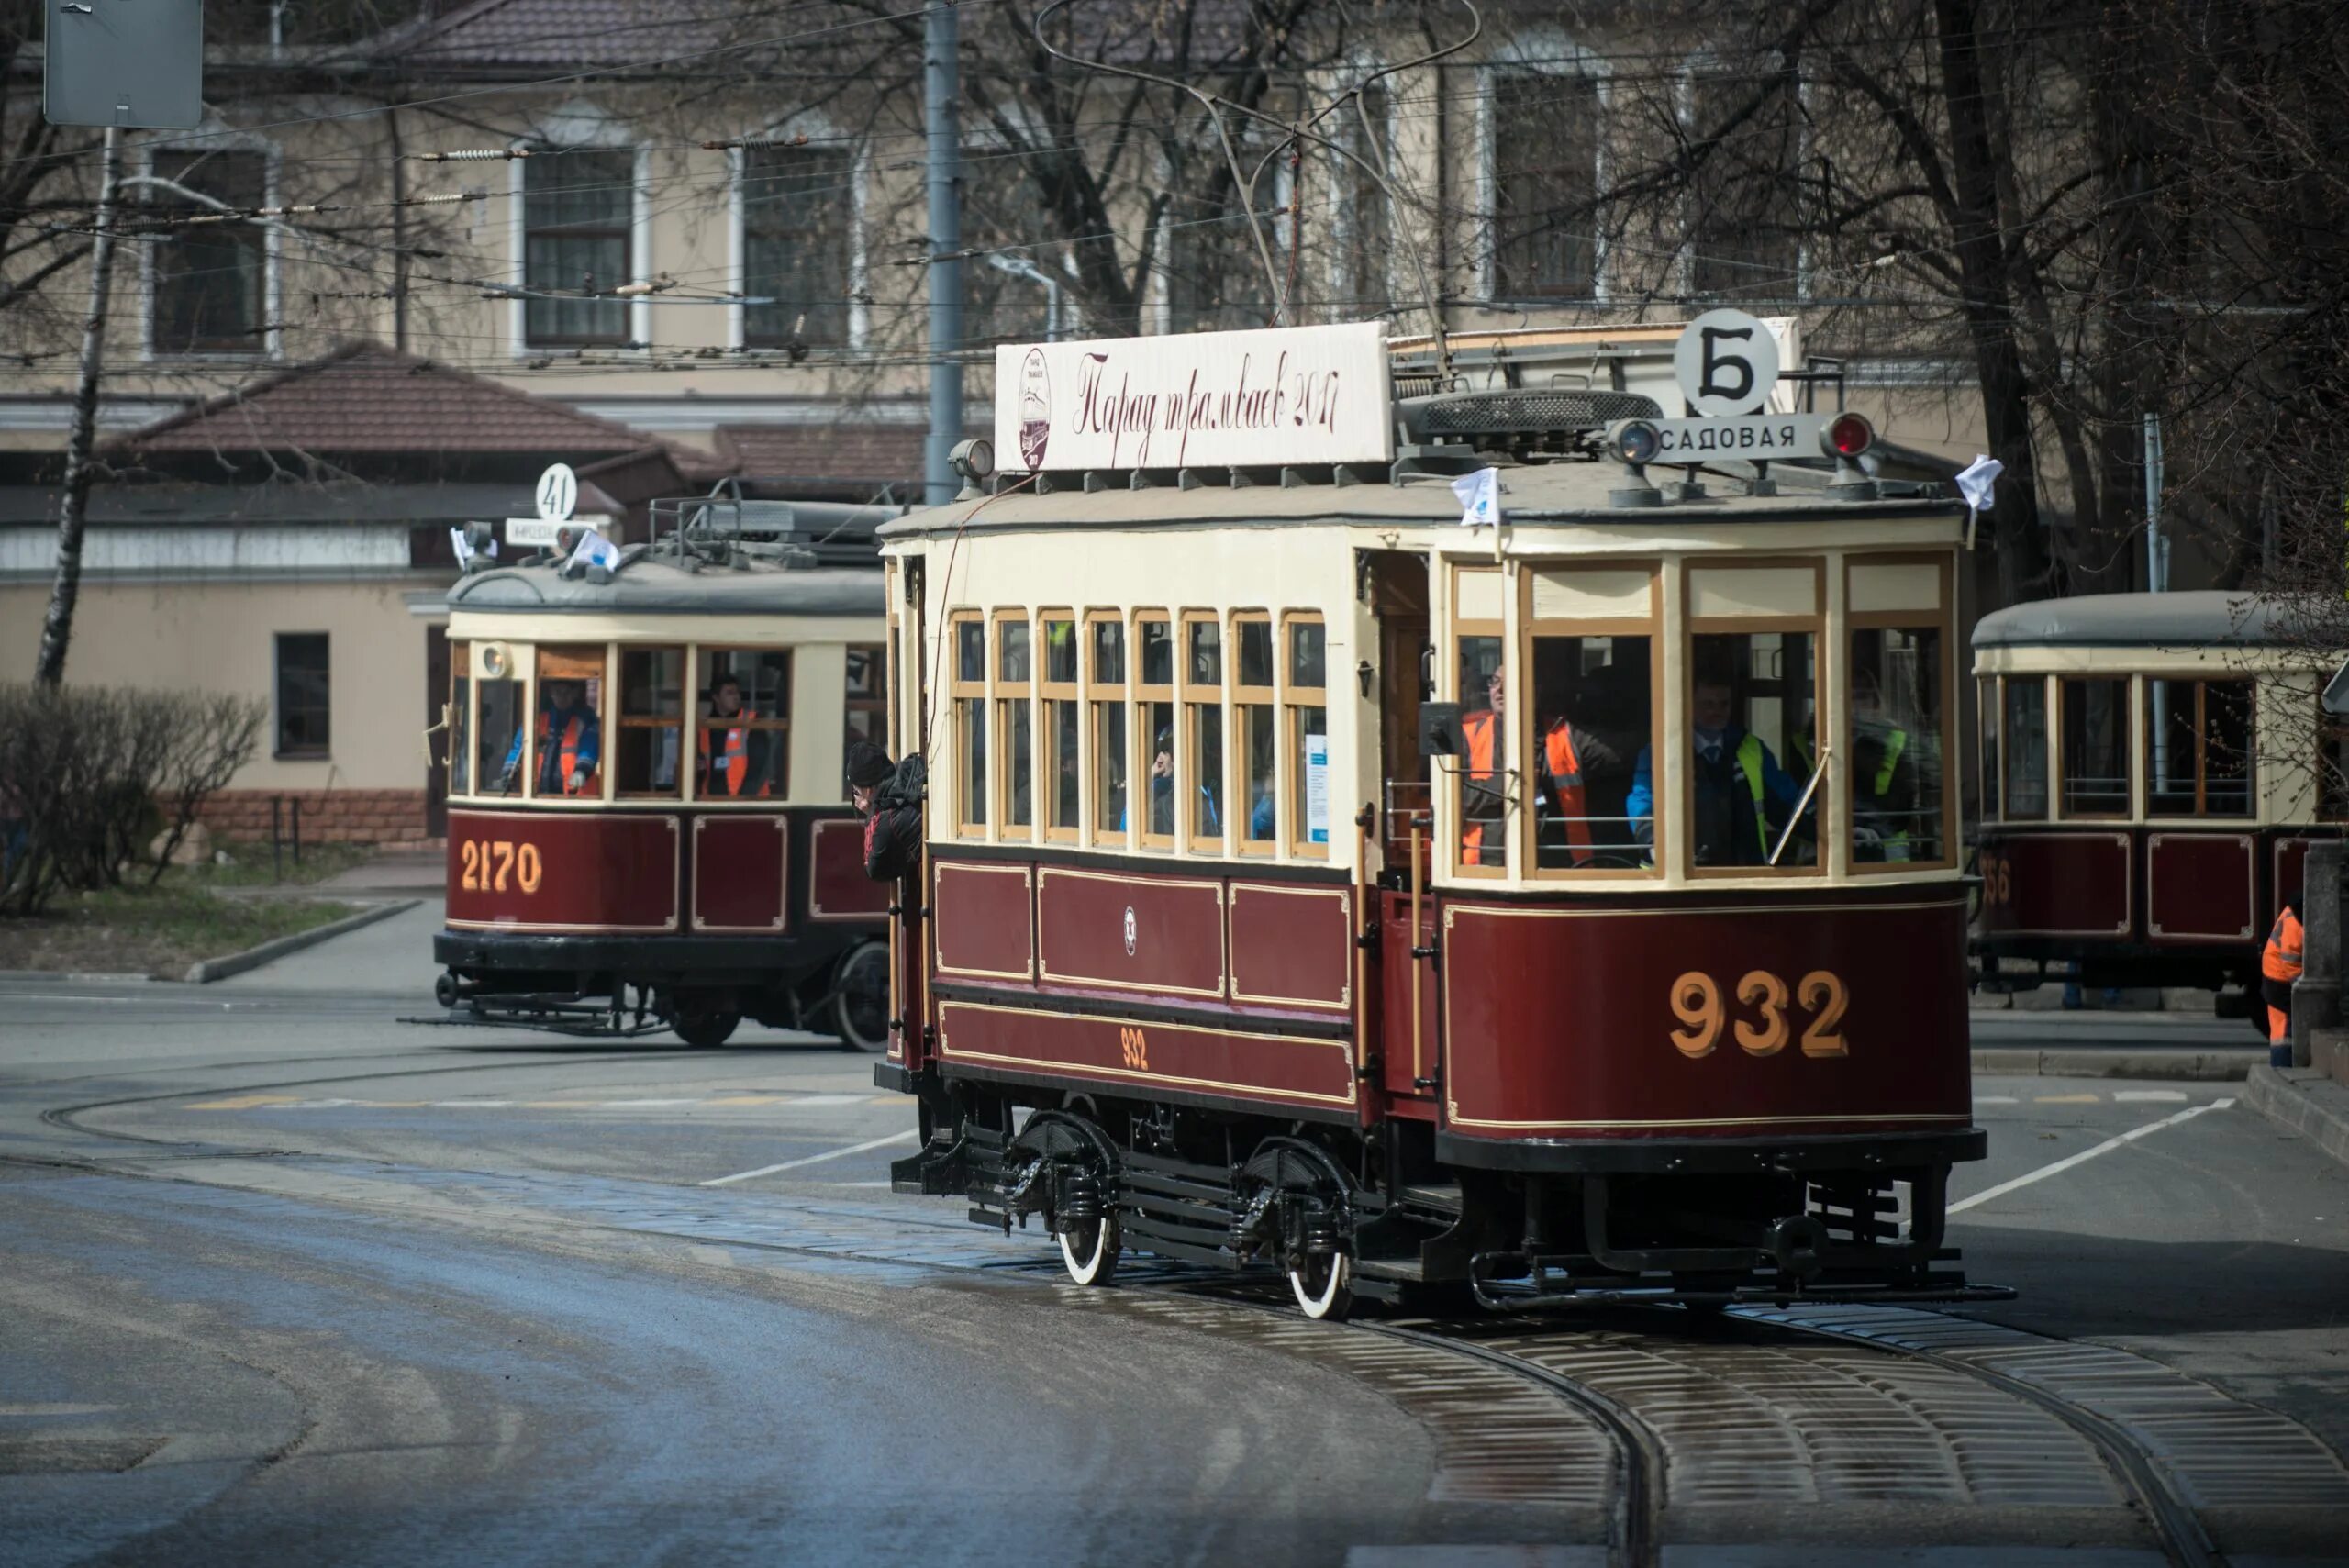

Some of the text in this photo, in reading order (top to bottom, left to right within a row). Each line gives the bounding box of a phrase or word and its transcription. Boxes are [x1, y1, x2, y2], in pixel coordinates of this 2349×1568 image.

[1699, 326, 1753, 400] Б
[1073, 350, 1339, 468] Парад трамваев 2017
[1659, 425, 1795, 450] САДОВАЯ
[543, 474, 567, 514] 41
[462, 840, 542, 893] 2170
[1670, 970, 1849, 1058] 932
[1121, 1027, 1148, 1071] 932
